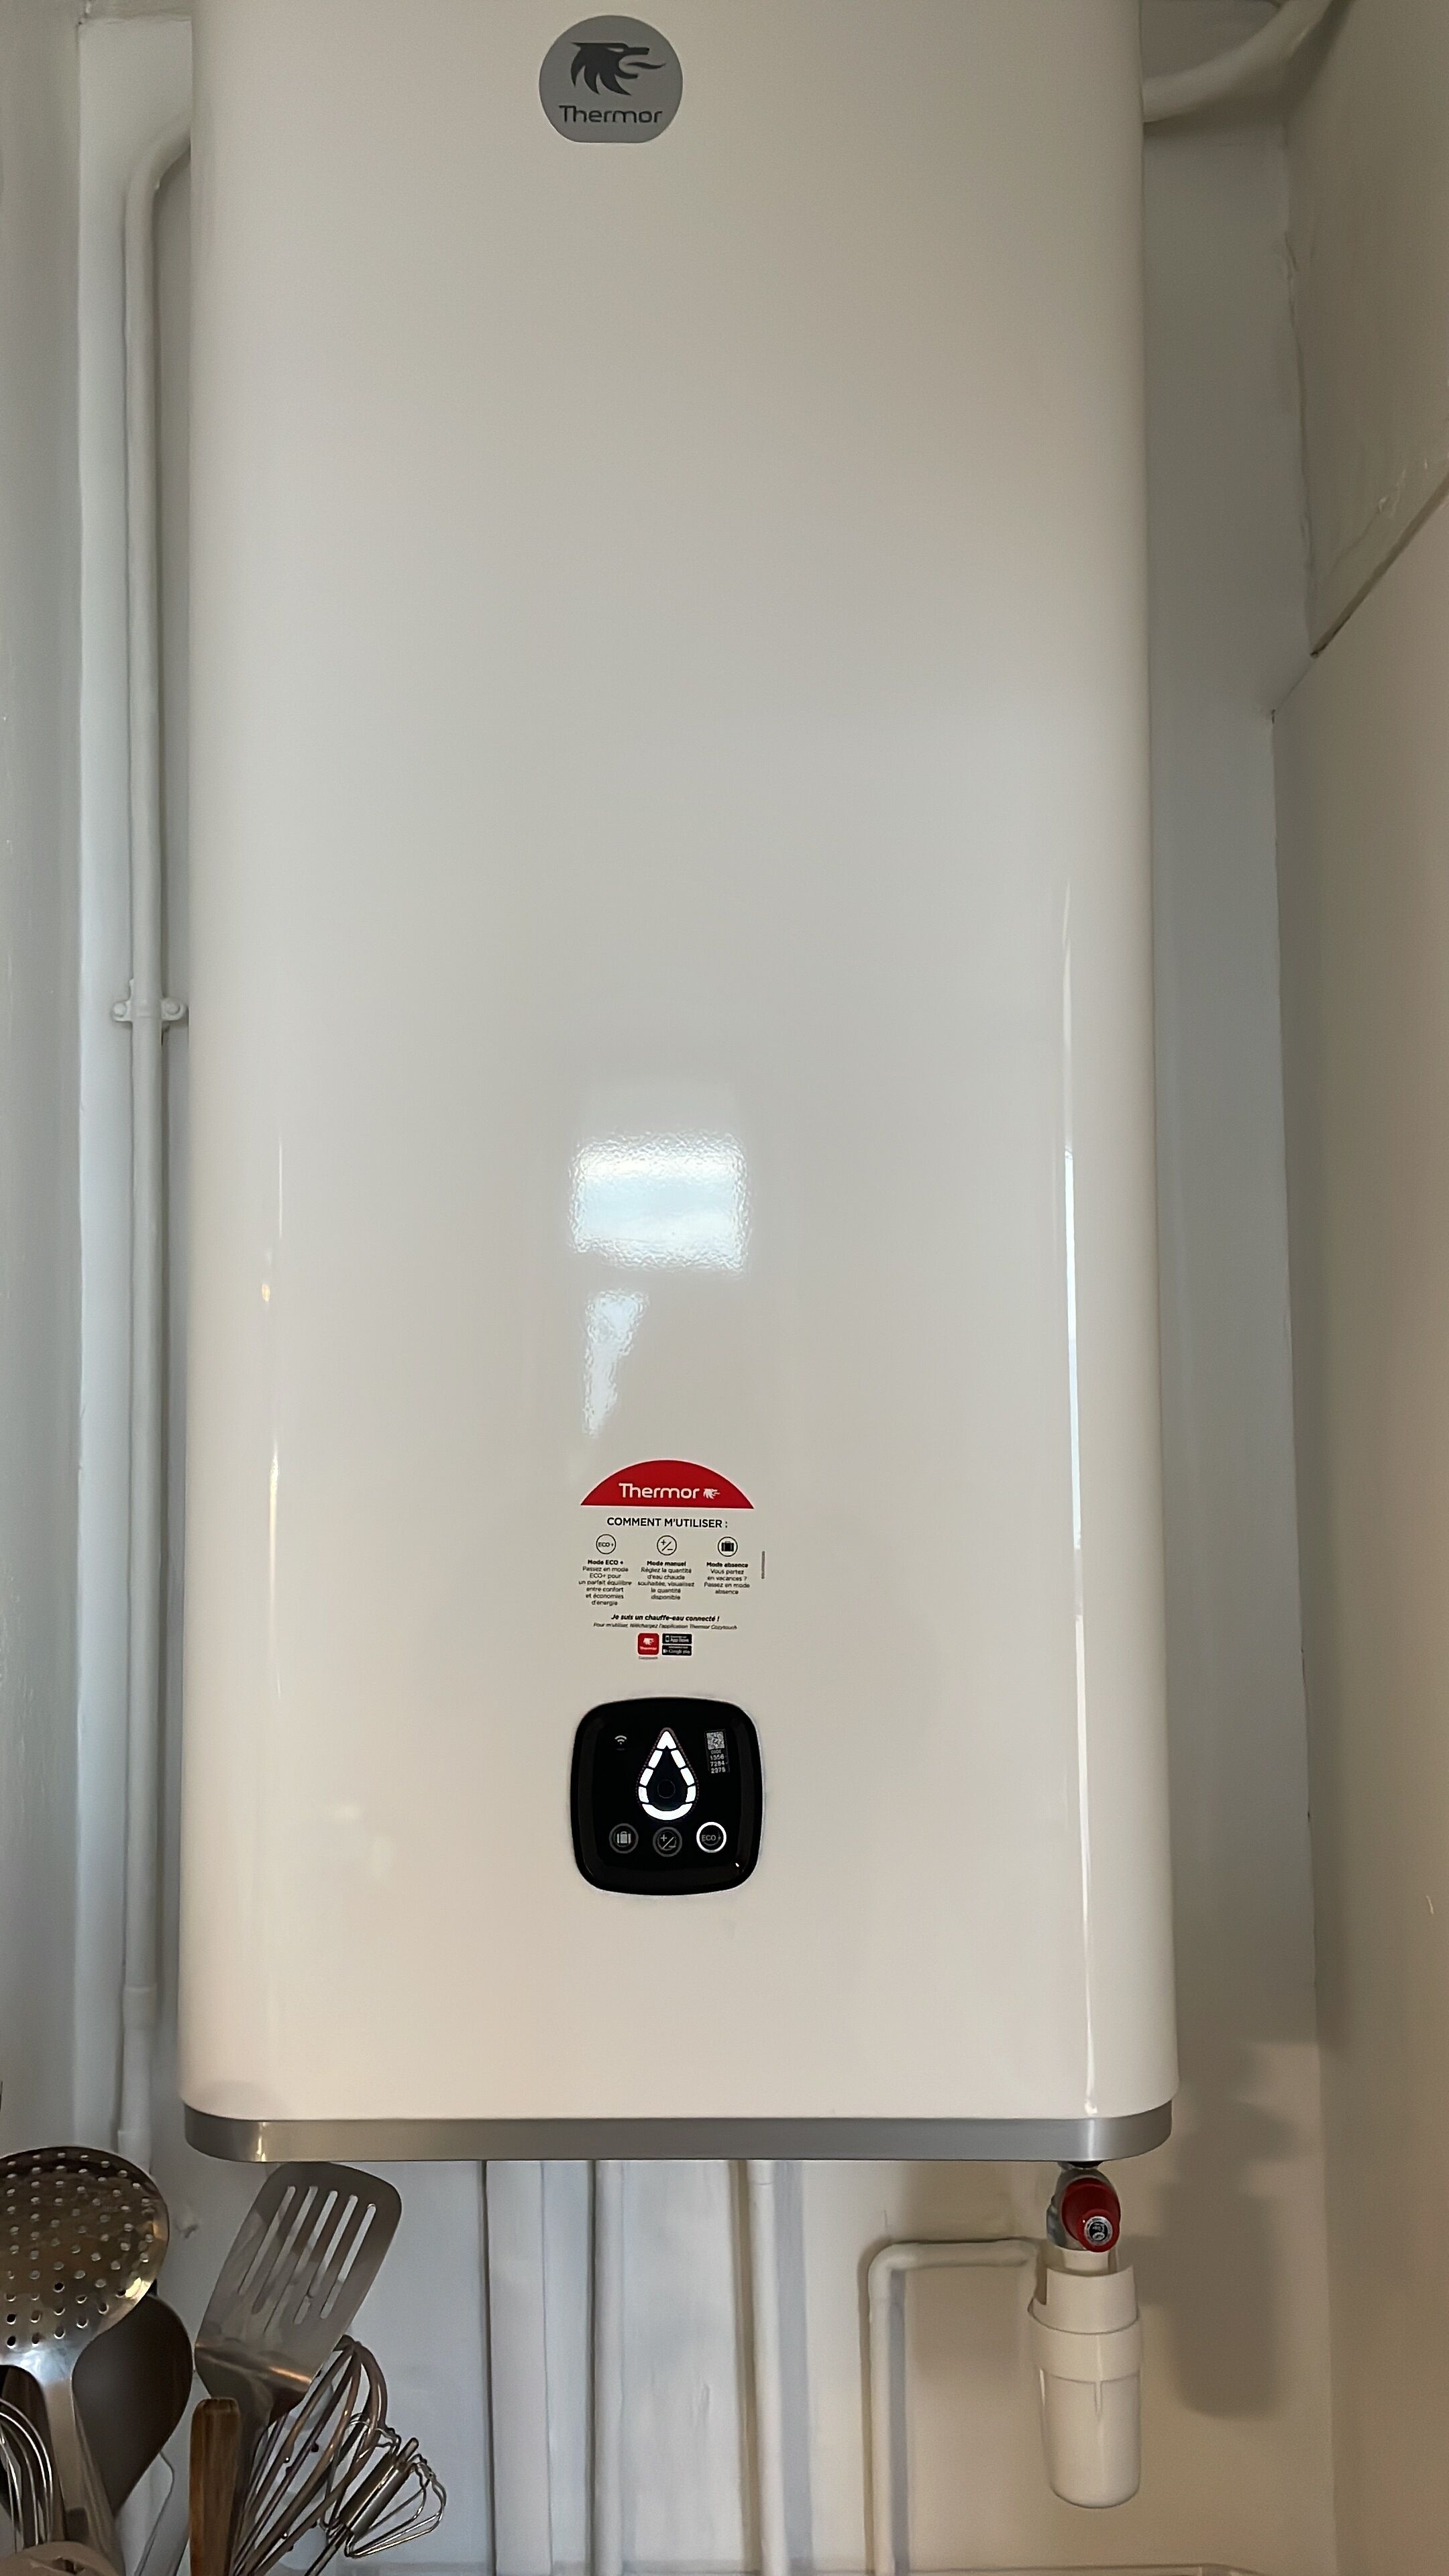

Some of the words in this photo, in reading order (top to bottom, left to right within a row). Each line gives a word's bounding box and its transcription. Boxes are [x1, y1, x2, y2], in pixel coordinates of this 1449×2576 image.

[558, 105, 663, 123] Thermor
[618, 1483, 700, 1499] Thermor
[606, 1517, 661, 1526] COMMENT
[664, 1518, 722, 1528] M'UTILISER
